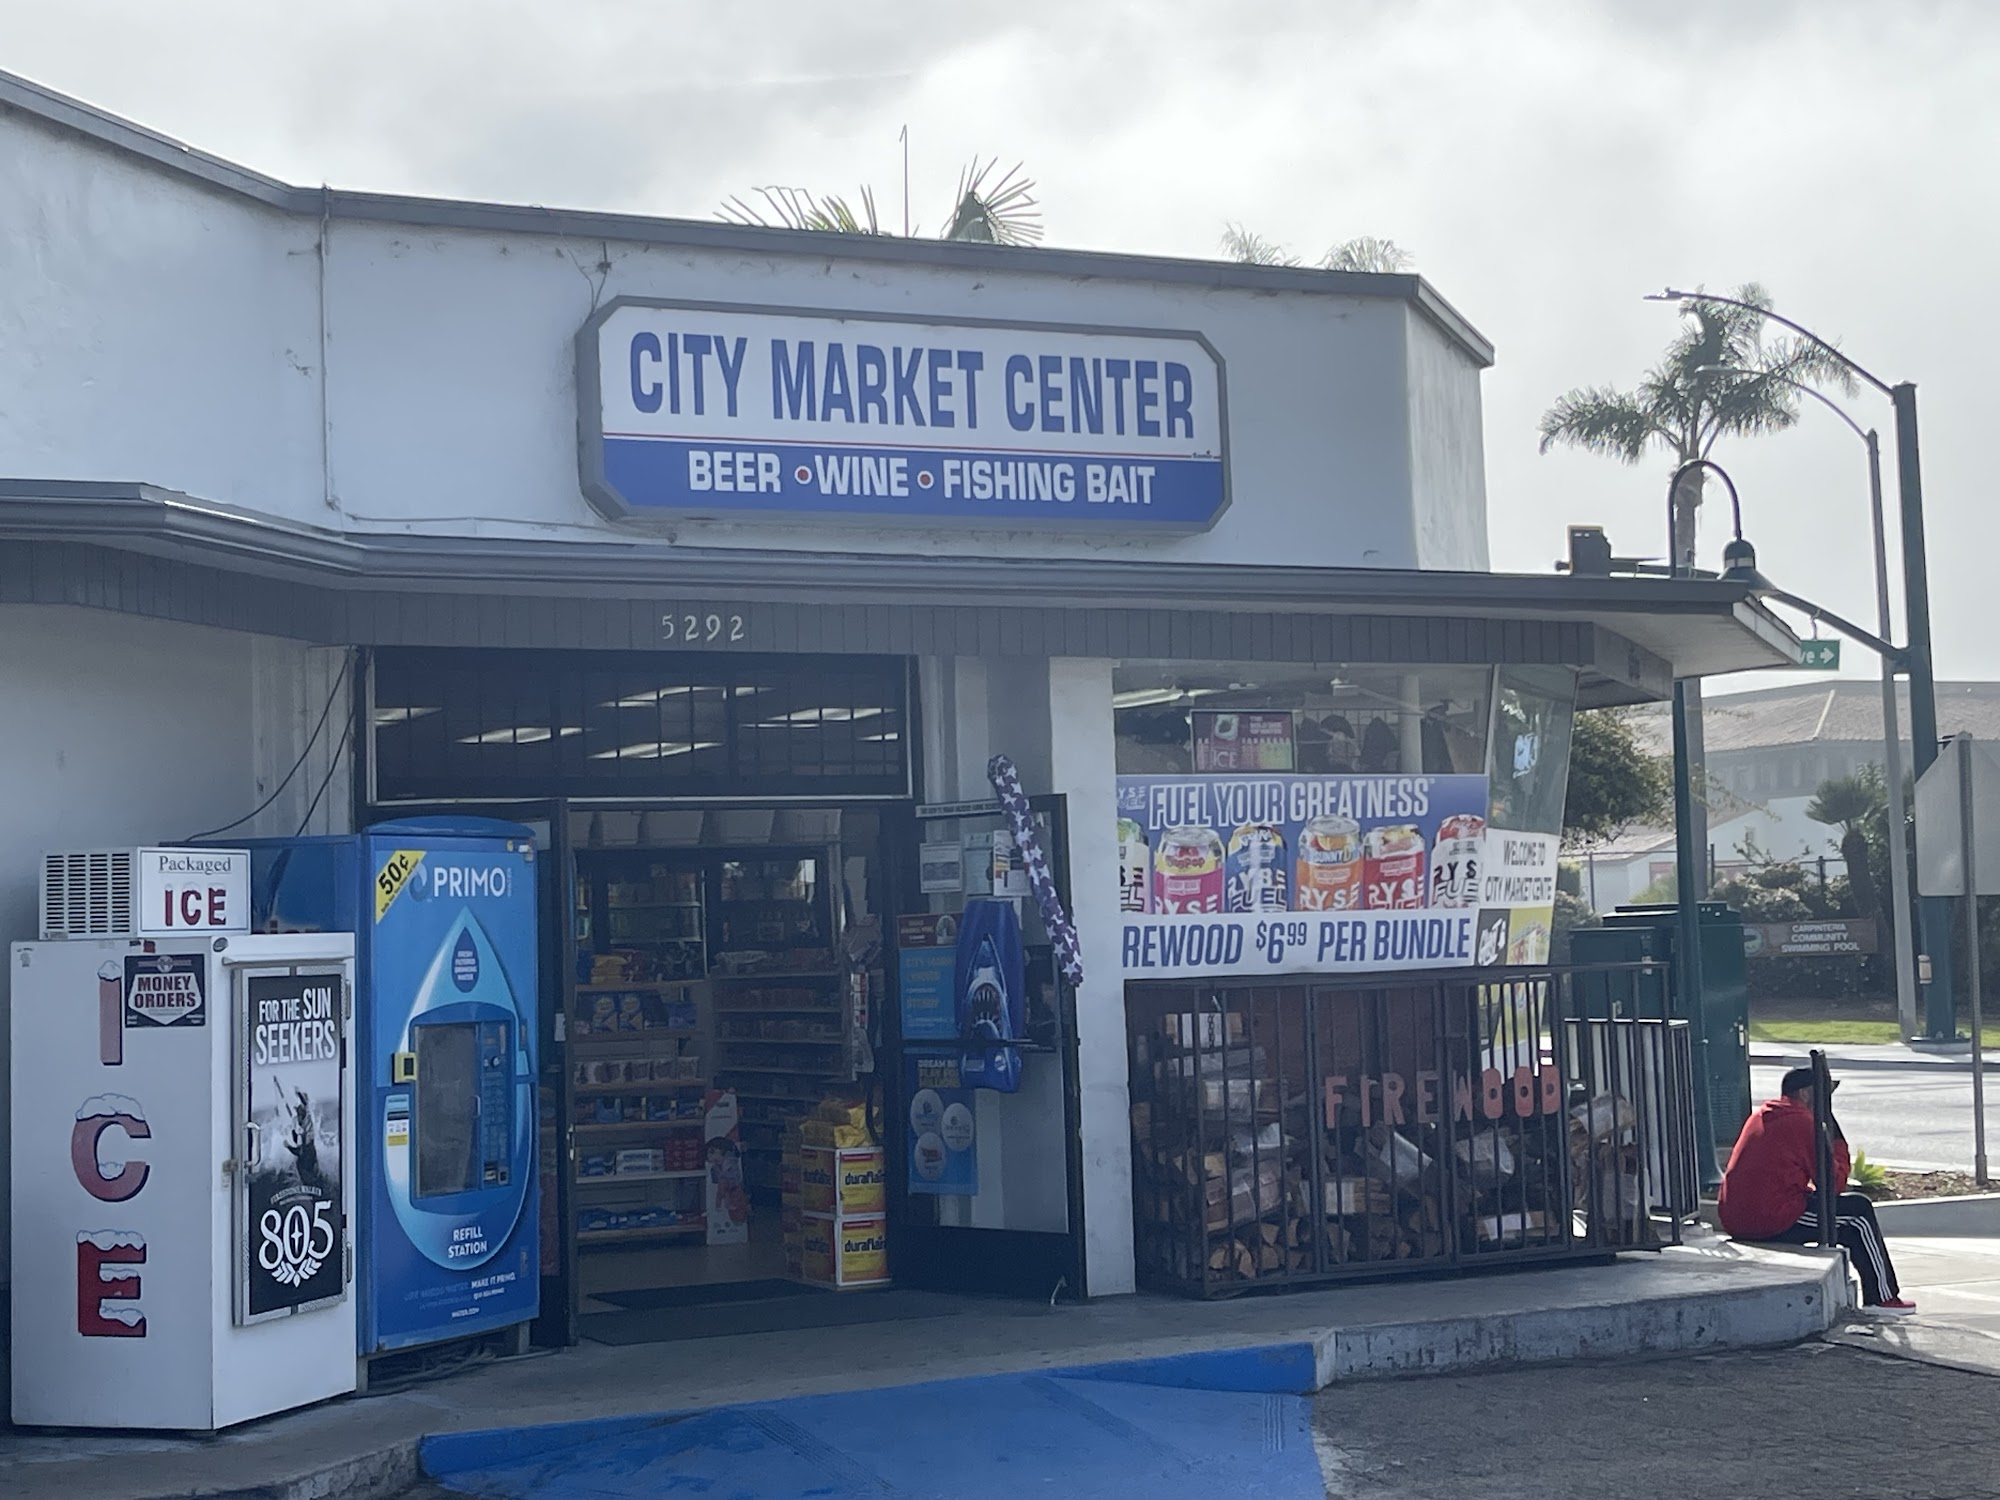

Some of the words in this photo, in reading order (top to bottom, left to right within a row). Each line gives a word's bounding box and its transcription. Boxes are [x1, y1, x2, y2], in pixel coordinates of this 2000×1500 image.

[630, 332, 747, 417] CITY
[771, 339, 983, 429] MARKET
[1005, 354, 1193, 438] CENTER
[688, 450, 781, 493] BEER
[814, 455, 909, 497] WINE
[943, 459, 1075, 502] FISHING
[1086, 464, 1155, 504] BAIT
[662, 614, 744, 642] 5292
[1149, 783, 1212, 830] FUEL
[1213, 781, 1285, 827] YOUR
[1290, 778, 1429, 822] GREATNESS
[159, 856, 231, 875] Packaged
[378, 854, 409, 895] 50¢
[434, 867, 506, 897] PRIMO
[165, 884, 226, 926] ICE
[1317, 920, 1367, 963] PER
[1373, 918, 1471, 961] BUNDLE
[1791, 932, 1848, 942] COMMUNITY
[1792, 923, 1846, 932] CARPINTERIA
[1781, 943, 1830, 953] SWIMMING
[1833, 942, 1860, 951] POOL
[134, 992, 196, 1008] ORDERS
[138, 976, 191, 991] MONEY
[259, 999, 280, 1023] FOR
[281, 998, 301, 1021] THE
[303, 987, 332, 1020] SUN
[255, 1020, 336, 1065] SEEKERS
[1324, 1064, 1561, 1129] FIREWOOD
[259, 1200, 334, 1270] 805
[447, 1240, 488, 1259] STATION
[453, 1226, 483, 1242] REFILL
